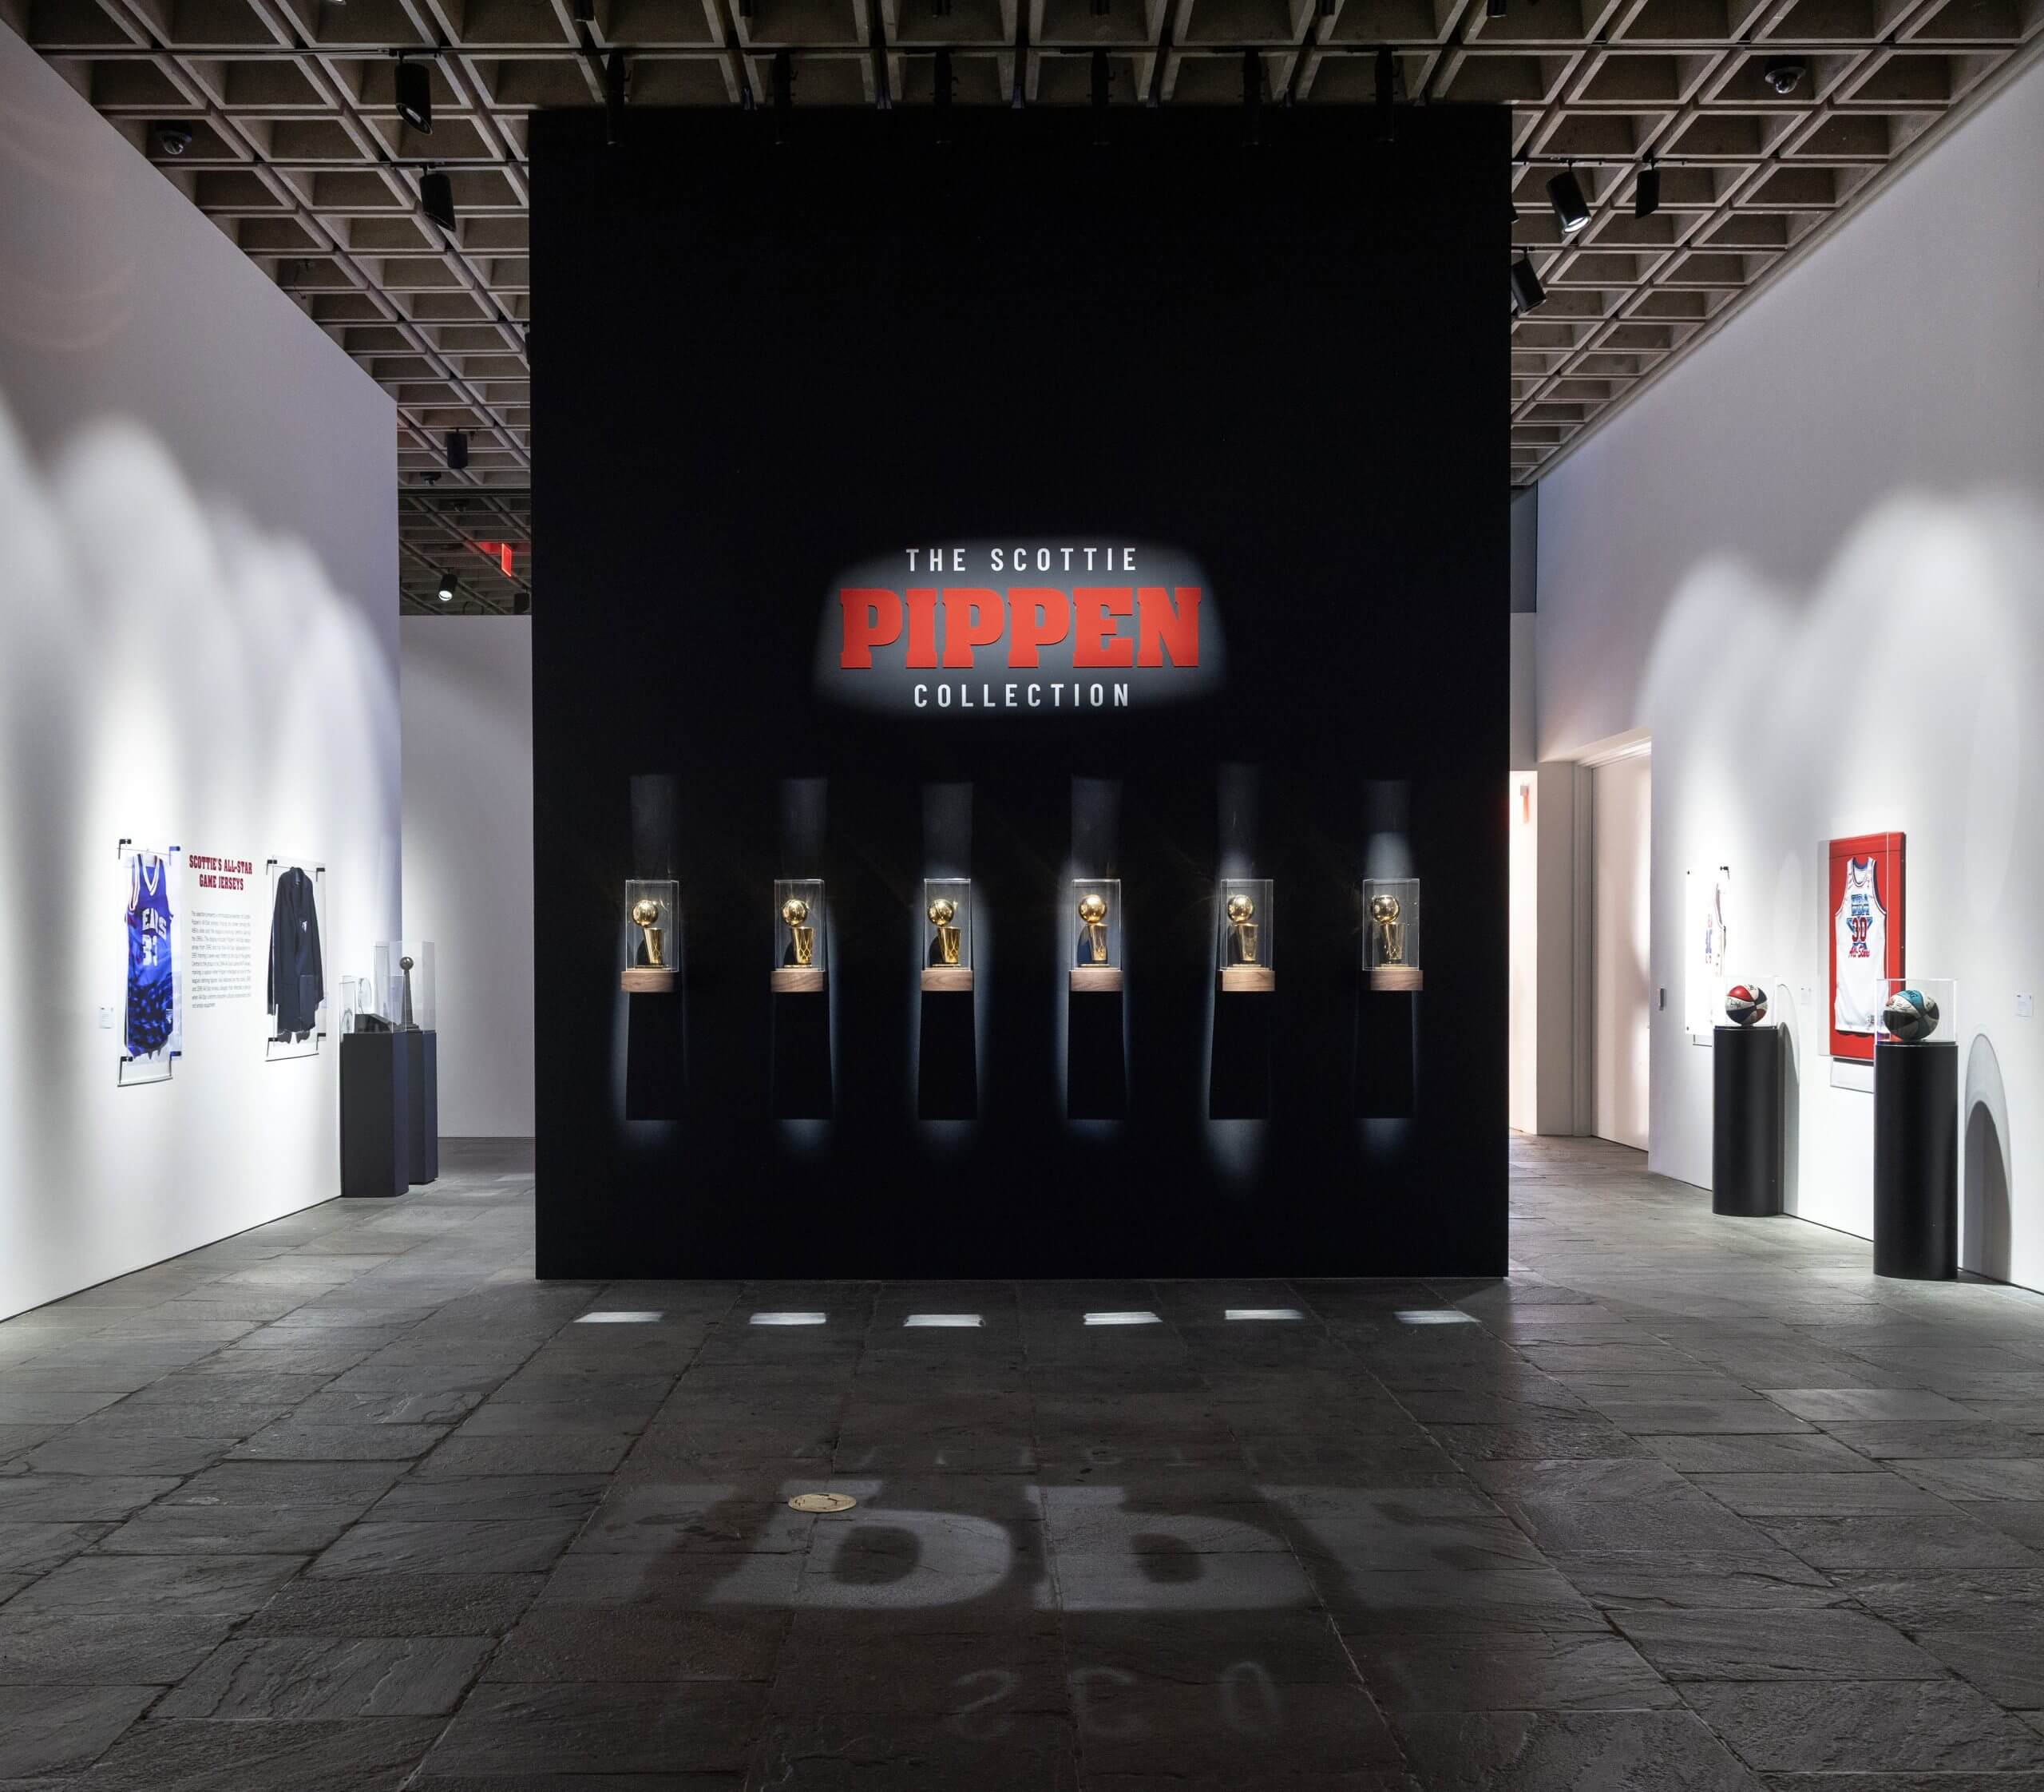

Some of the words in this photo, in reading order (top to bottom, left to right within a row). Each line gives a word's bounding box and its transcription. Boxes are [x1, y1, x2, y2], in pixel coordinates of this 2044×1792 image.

[905, 548, 966, 572] THE
[991, 547, 1136, 572] SCOTTIE
[840, 587, 1202, 669] PIPPEN
[913, 683, 1129, 708] COLLECTION
[189, 854, 222, 871] SCOTTIE'S
[224, 858, 253, 874] ALL-STAR
[199, 874, 217, 888] GAME
[218, 875, 244, 890] JERSEYS
[1852, 917, 1867, 942] 30
